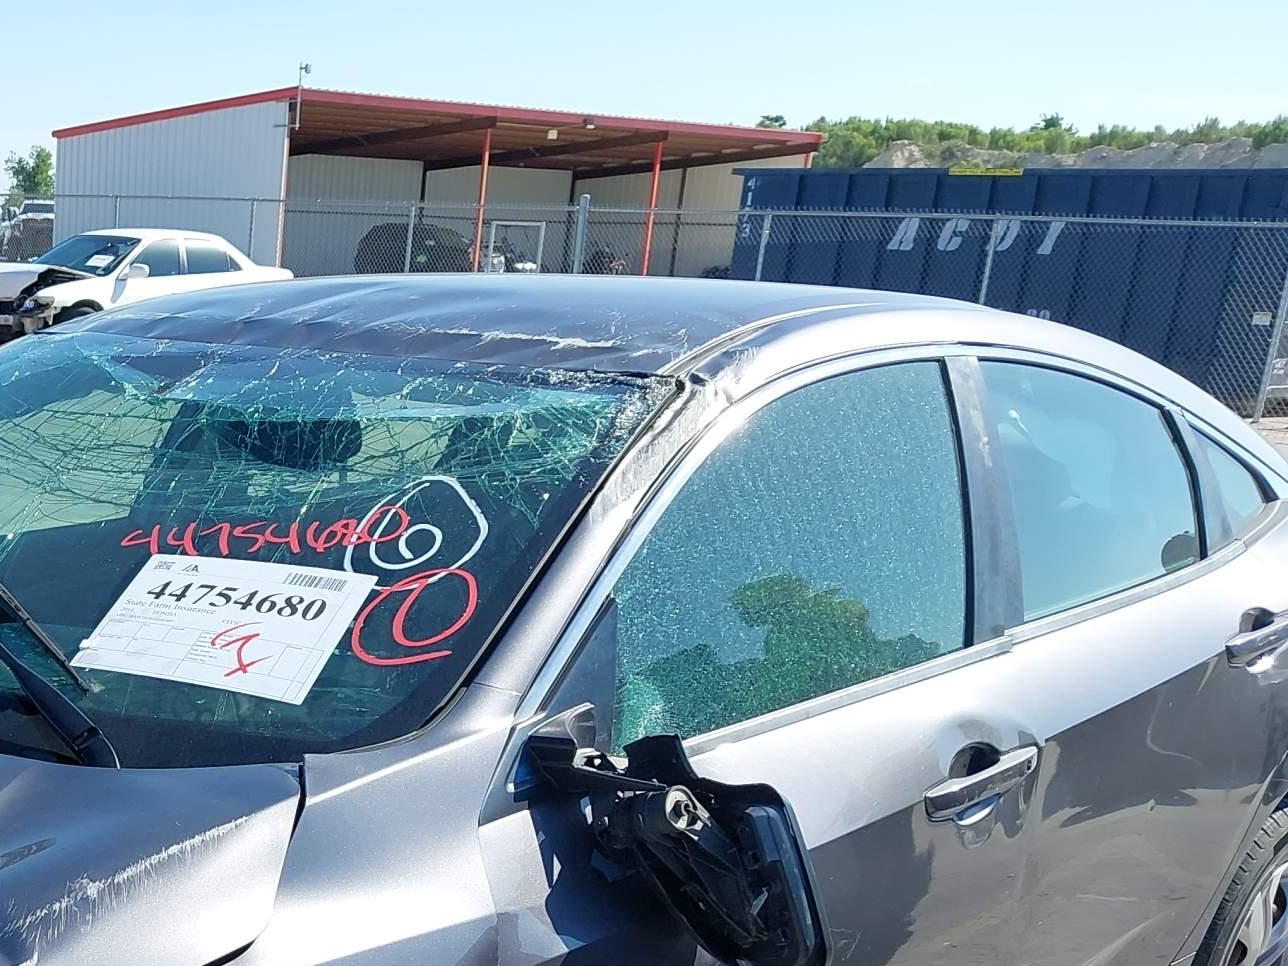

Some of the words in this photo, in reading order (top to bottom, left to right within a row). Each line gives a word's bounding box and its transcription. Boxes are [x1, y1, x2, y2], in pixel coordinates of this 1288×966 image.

[120, 505, 409, 557] 44754680
[124, 599, 147, 608] State
[148, 600, 172, 611] Farm
[173, 603, 217, 615] Insurance
[146, 580, 327, 622] 44754680
